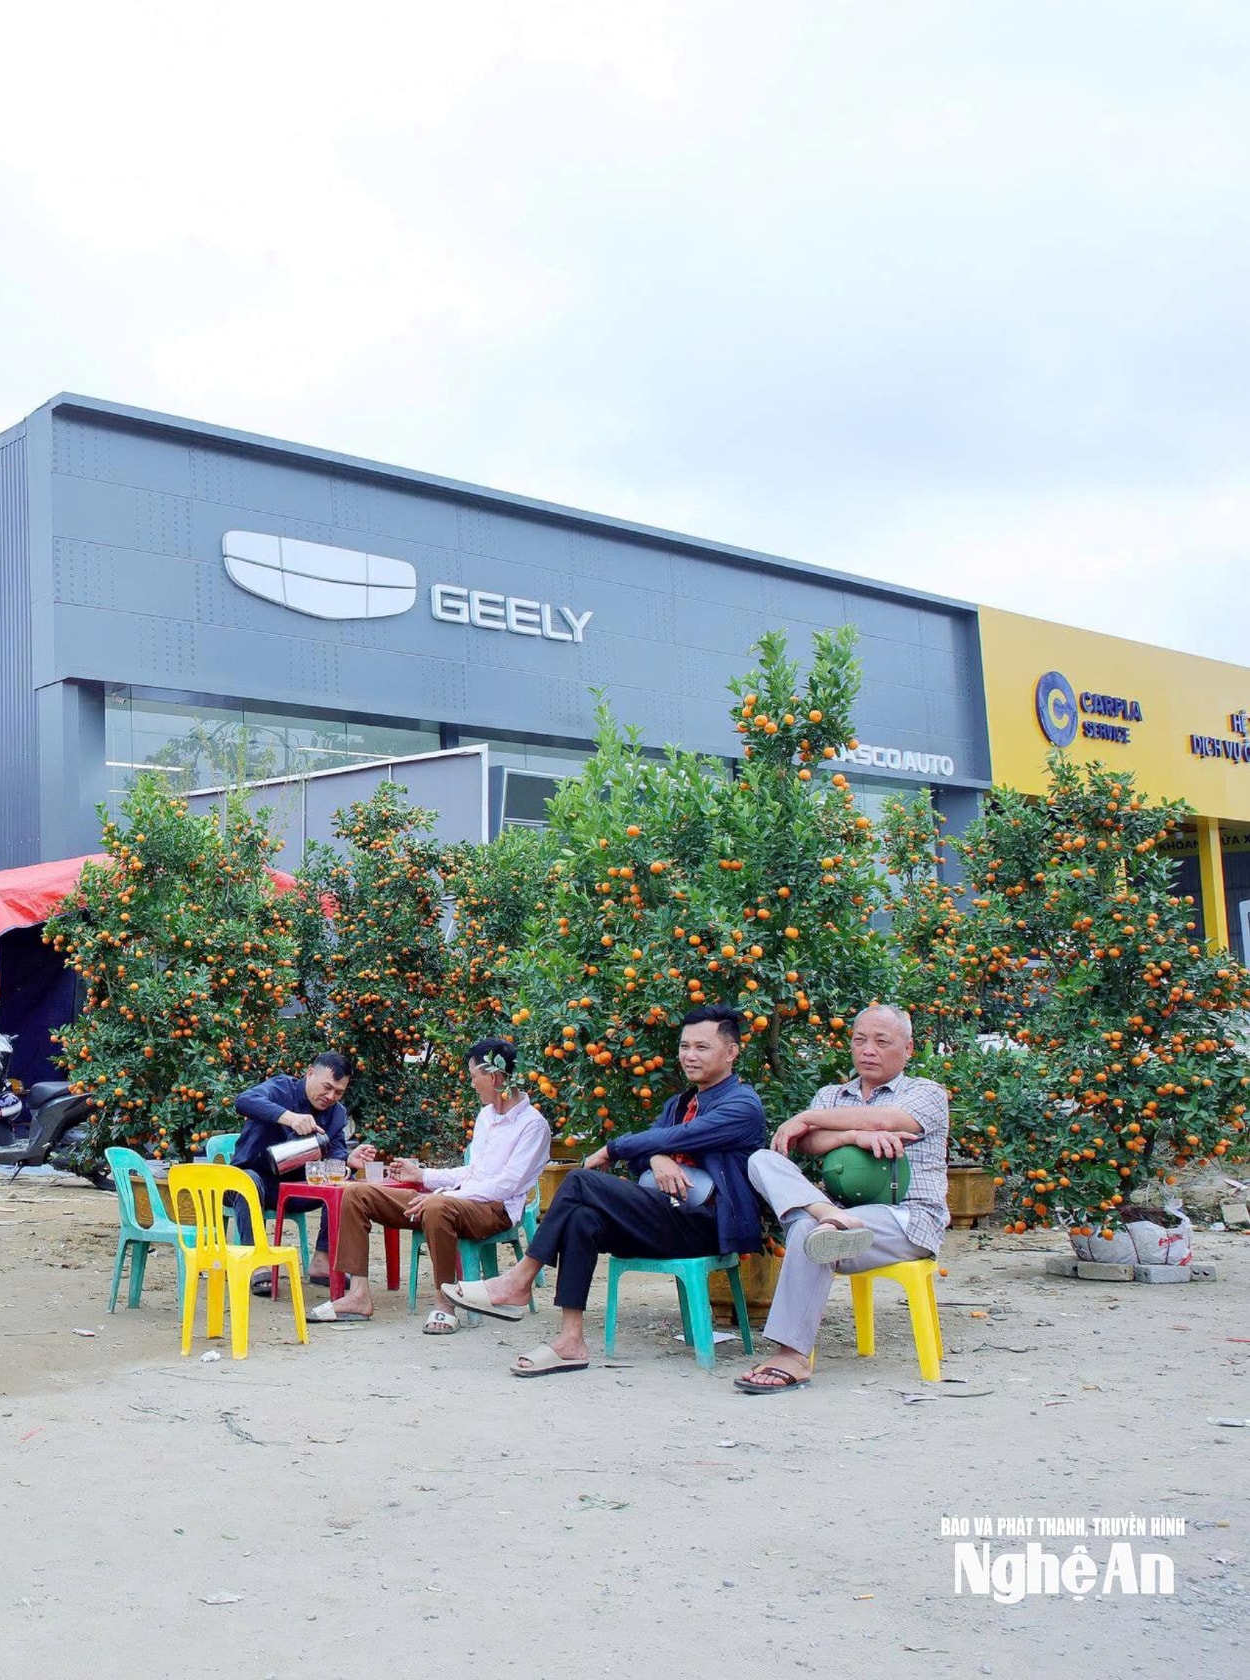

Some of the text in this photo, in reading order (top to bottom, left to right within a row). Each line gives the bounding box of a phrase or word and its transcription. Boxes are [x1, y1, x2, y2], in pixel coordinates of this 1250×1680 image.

[431, 583, 594, 643] GEELY
[1079, 691, 1143, 722] CARPLA
[1082, 720, 1131, 744] SERVICE
[1190, 734, 1222, 759] DỊCH
[1222, 740, 1241, 764] VỤ
